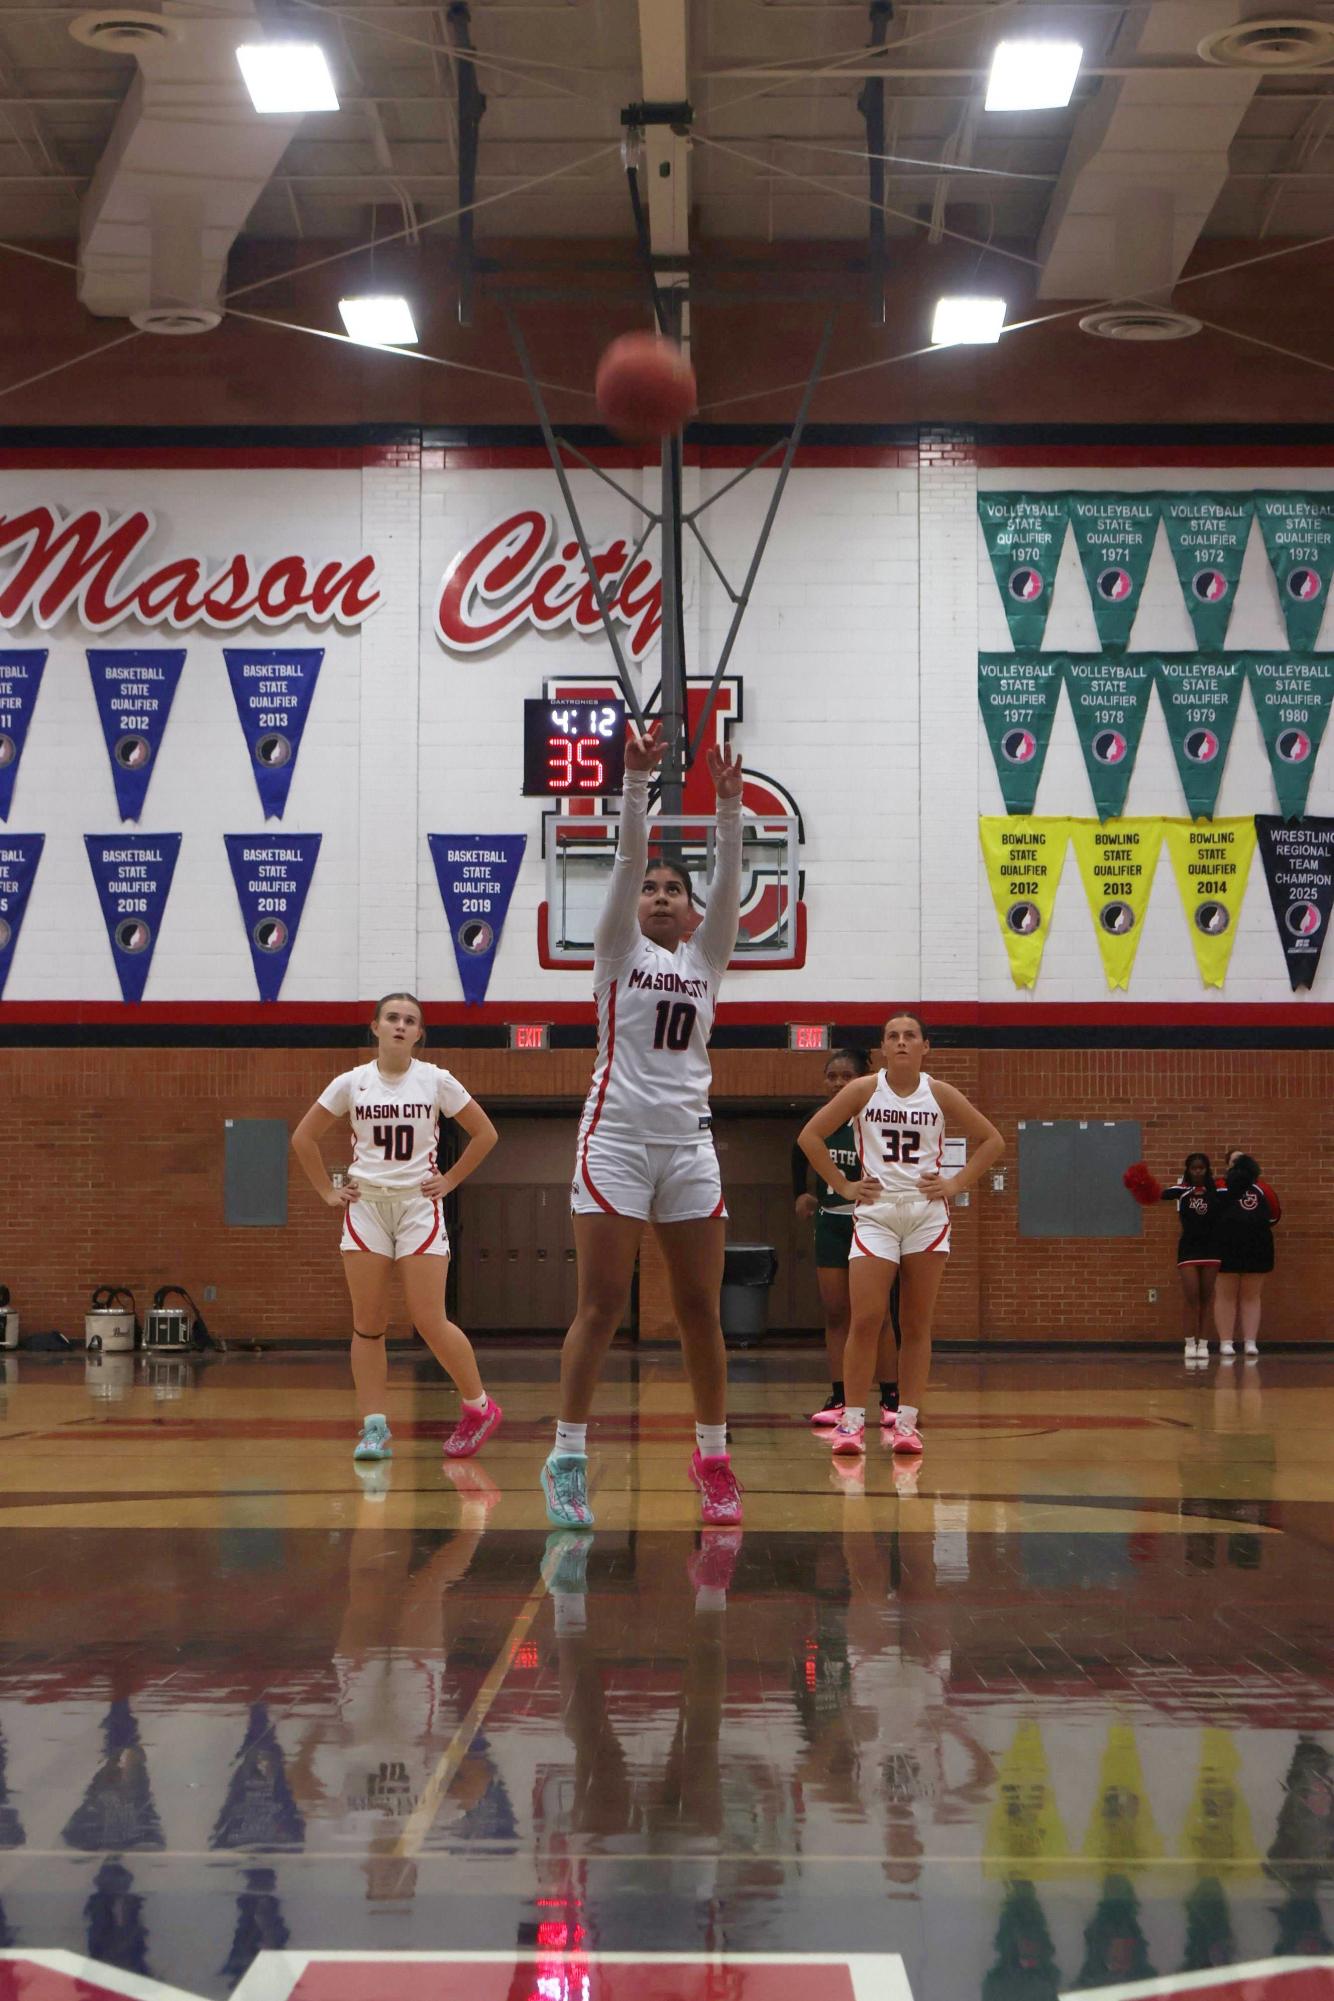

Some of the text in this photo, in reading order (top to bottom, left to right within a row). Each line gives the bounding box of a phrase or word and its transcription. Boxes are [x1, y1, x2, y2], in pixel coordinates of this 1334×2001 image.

[987, 504, 1062, 517] VOLLEYBALL
[1077, 504, 1153, 517] VOLLEYBALL
[1170, 505, 1247, 518] VOLLEYBALL
[1007, 518, 1042, 530] STATE
[1097, 519, 1132, 530] STATE
[1190, 520, 1227, 531] STATE
[1286, 518, 1321, 530] STATE
[997, 533, 1052, 544] QUALIFIER
[1087, 533, 1143, 544] QUALIFIER
[1180, 534, 1237, 545] QUALIFIER
[1275, 532, 1331, 544] QUALIFIER
[1012, 548, 1040, 561] 1970
[1101, 549, 1130, 561] 1971
[1194, 549, 1224, 563] 1972
[1289, 548, 1319, 561] 1973
[0, 506, 664, 657] Mason City
[105, 667, 165, 680] BASKETBALL
[243, 664, 304, 677] BASKETBALL
[980, 665, 1056, 677] VOLLEYBALL
[1071, 665, 1147, 678] VOLLEYBALL
[1162, 664, 1239, 677] VOLLEYBALL
[1255, 664, 1331, 677] VOLLEYBALL
[120, 684, 150, 696] STATE
[259, 681, 288, 693] STATE
[1000, 679, 1036, 691] STATE
[1091, 680, 1127, 692] STATE
[1182, 679, 1218, 691] STATE
[1275, 679, 1311, 691] STATE
[111, 699, 159, 711] QUALIFIER
[249, 696, 298, 708] QUALIFIER
[990, 694, 1046, 705] QUALIFIER
[1080, 694, 1137, 706] QUALIFIER
[1172, 693, 1229, 705] QUALIFIER
[1265, 694, 1321, 705] QUALIFIER
[259, 713, 288, 727] 2013
[1003, 709, 1033, 722] 1977
[1094, 710, 1124, 724] 1978
[1186, 709, 1216, 722] 1979
[1279, 709, 1308, 722] 1980
[120, 716, 149, 730] 2012
[551, 707, 617, 737] 4:12
[549, 738, 603, 787] 35
[1002, 834, 1046, 846] BOWLING
[1095, 833, 1140, 846] BOWLING
[1189, 832, 1235, 844] BOWLING
[102, 850, 163, 862] BASKETBALL
[243, 849, 304, 861] BASKETBALL
[447, 850, 507, 863] BASKETBALL
[1009, 850, 1038, 861] STATE
[1103, 850, 1132, 861] STATE
[1198, 848, 1227, 860] STATE
[1276, 845, 1331, 857] REGIONAL
[1000, 865, 1047, 876] QUALIFIER
[1094, 864, 1142, 876] QUALIFIER
[1188, 863, 1236, 875] QUALIFIER
[1289, 859, 1319, 870] TEAM
[118, 866, 147, 878] STATE
[258, 865, 288, 877] STATE
[463, 867, 491, 878] STATE
[1275, 873, 1331, 885] CHAMPION
[108, 881, 157, 893] QUALIFIER
[248, 881, 297, 892] QUALIFIER
[453, 882, 501, 894] QUALIFIER
[1010, 882, 1039, 895] 2012
[1103, 882, 1133, 895] 2013
[1197, 881, 1227, 894] 2014
[1289, 887, 1318, 900] 2025
[117, 899, 148, 912] 2016
[258, 898, 287, 911] 2018
[462, 899, 492, 913] 2019
[628, 968, 687, 994] MASON
[653, 1000, 697, 1051] 10
[517, 1027, 543, 1047] EXIT
[797, 1028, 823, 1047] EXIT
[355, 1103, 432, 1120] MASON CITY
[865, 1108, 938, 1126] MASON CITY
[373, 1124, 415, 1161] 40
[881, 1128, 921, 1164] 32
